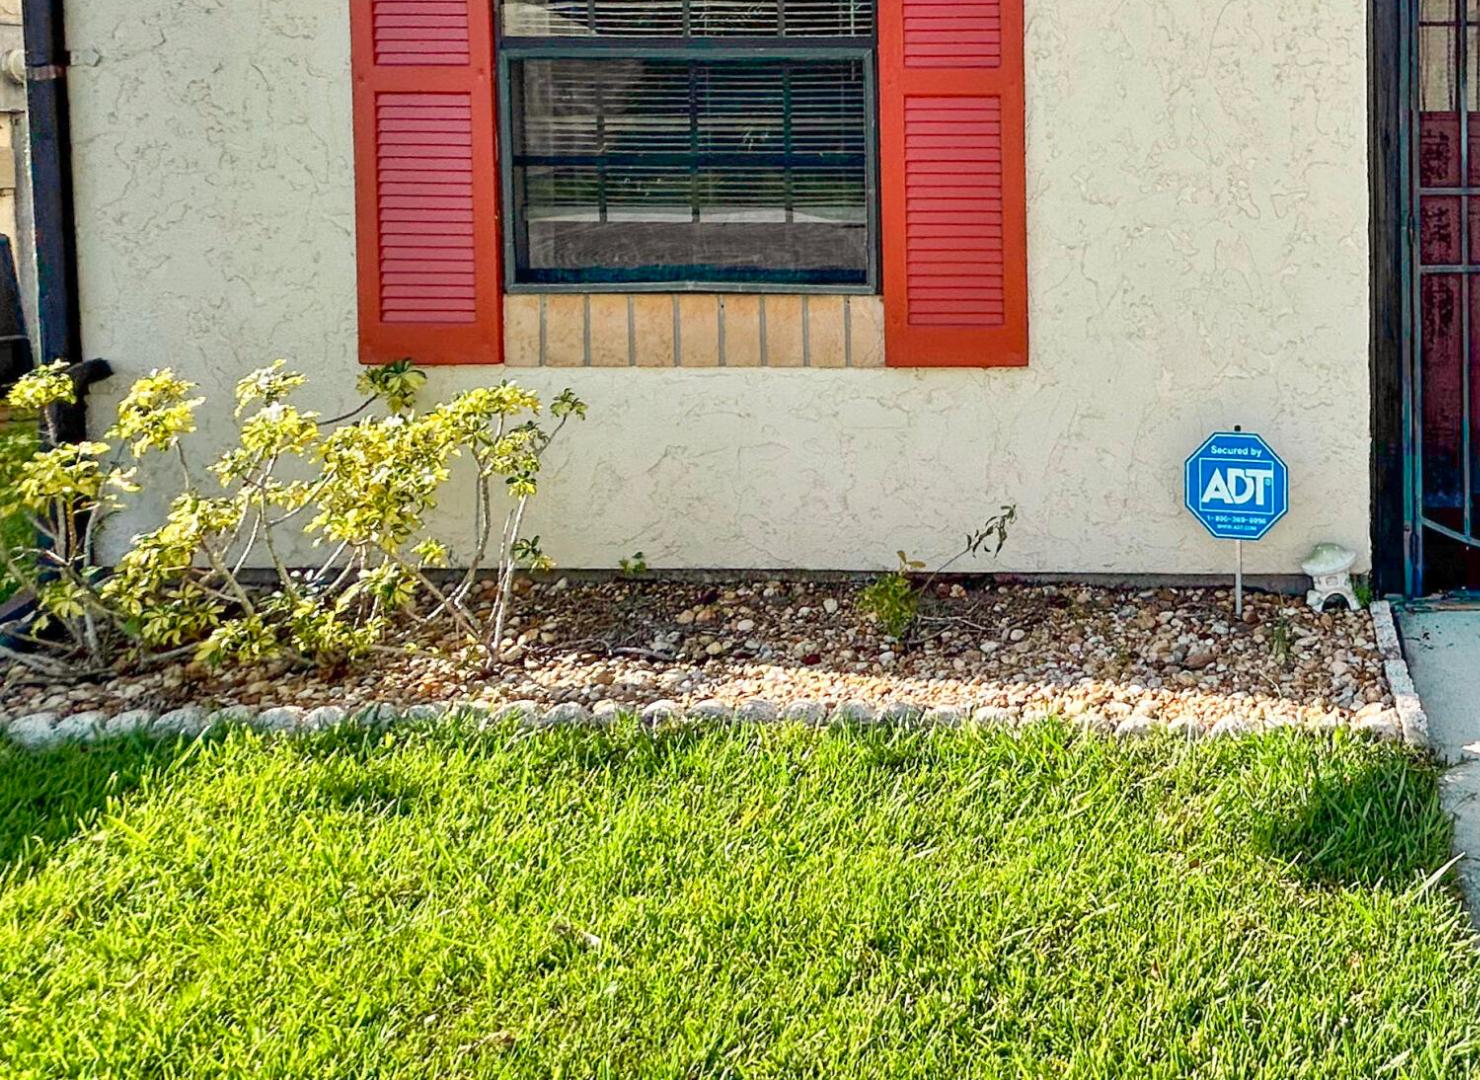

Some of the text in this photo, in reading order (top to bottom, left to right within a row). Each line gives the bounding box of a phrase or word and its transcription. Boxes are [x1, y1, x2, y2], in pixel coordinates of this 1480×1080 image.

[1210, 445, 1262, 458] Secured by
[1201, 467, 1273, 505] ADT
